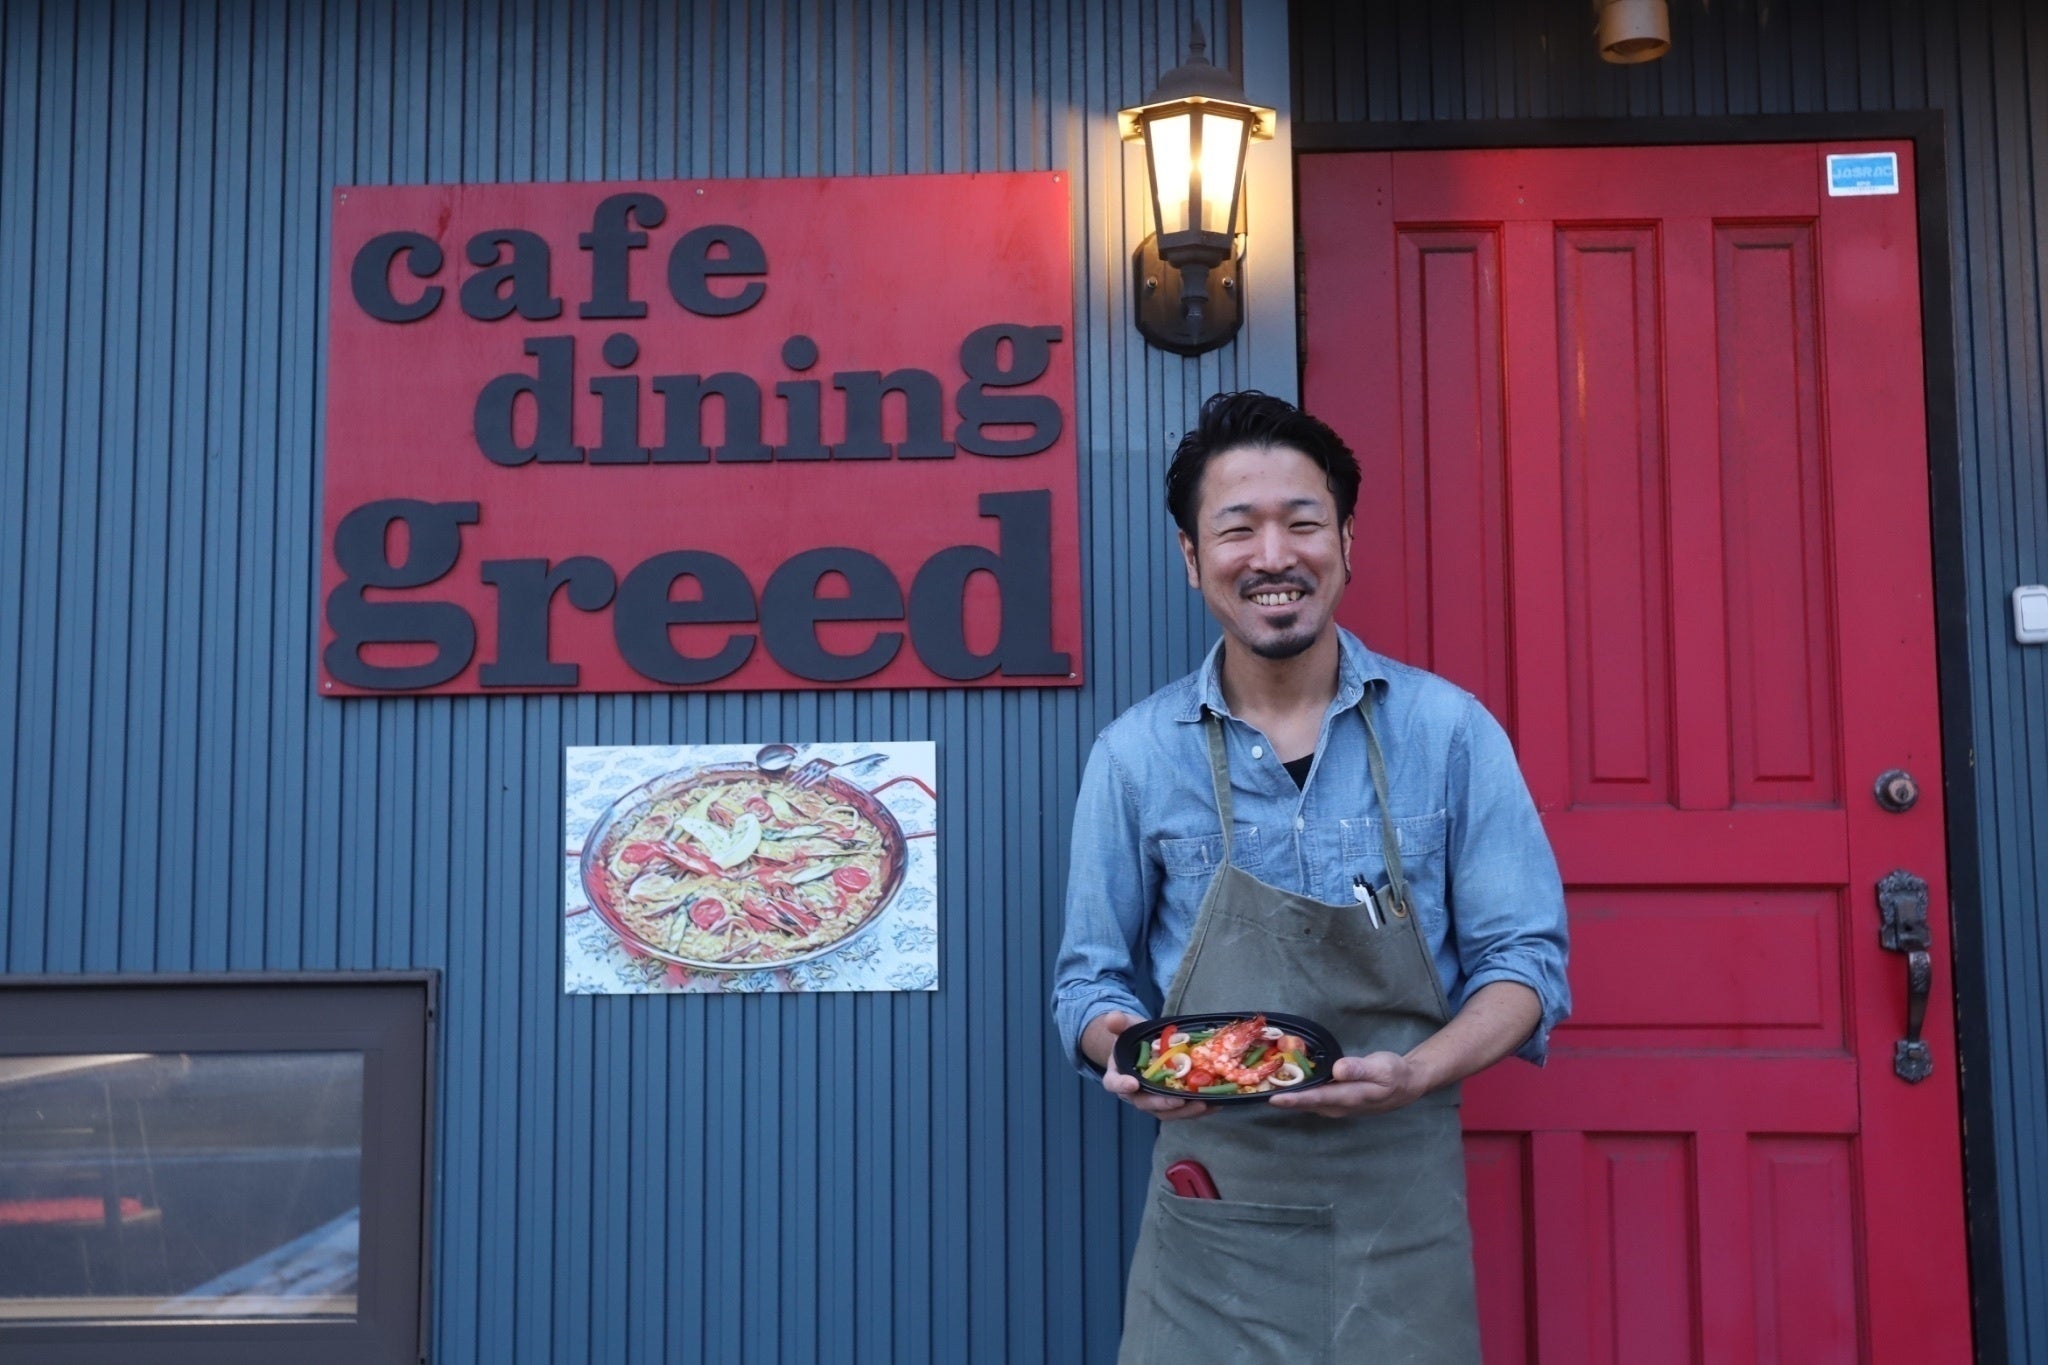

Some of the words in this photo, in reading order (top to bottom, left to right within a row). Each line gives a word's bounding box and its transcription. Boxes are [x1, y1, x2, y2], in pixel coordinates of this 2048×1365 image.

[351, 192, 767, 323] cafe
[474, 323, 1063, 467] dining
[324, 489, 1071, 689] greed
